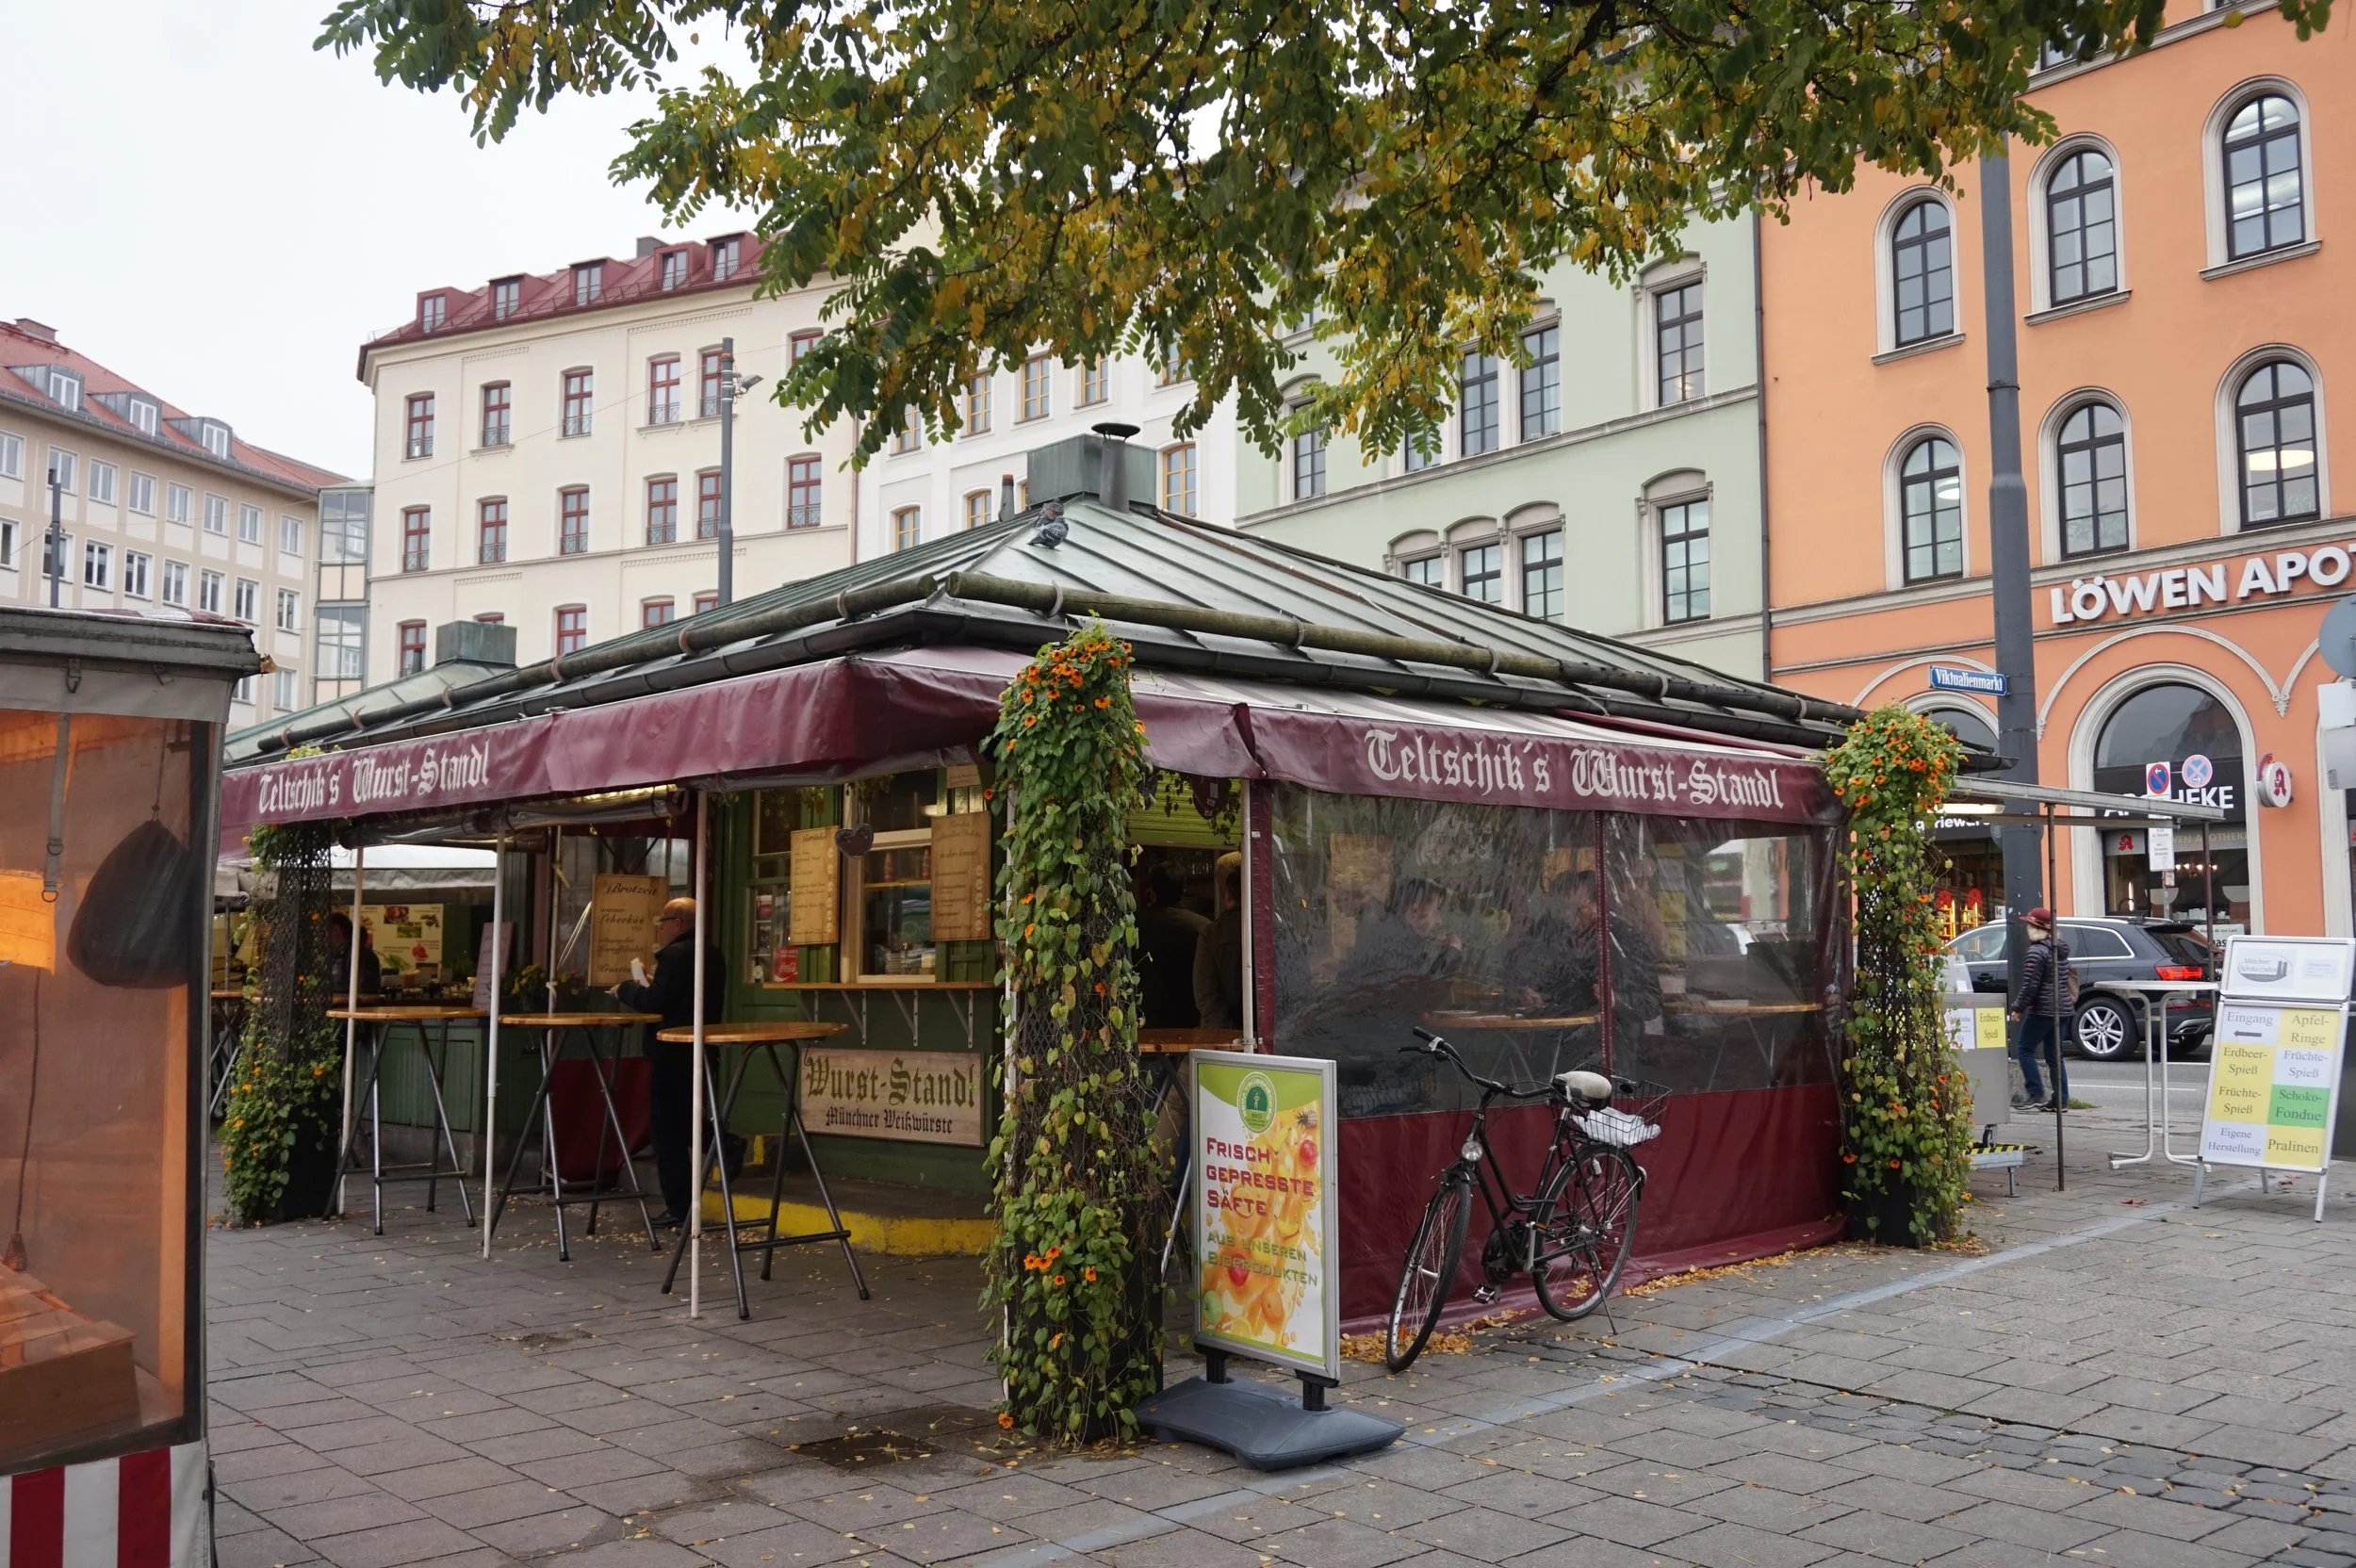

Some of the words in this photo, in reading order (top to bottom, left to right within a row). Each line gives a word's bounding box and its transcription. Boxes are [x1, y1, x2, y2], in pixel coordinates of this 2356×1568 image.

[2050, 564, 2228, 625] LÖWEN
[2236, 544, 2356, 598] APO
[1935, 668, 2004, 692] Viktualienmarkt
[352, 740, 489, 804] Wurst-Standl
[1570, 747, 1785, 809] Wurst-Standl
[2227, 1011, 2274, 1026] Eingang
[2291, 1014, 2330, 1028] Apfel-
[2290, 1032, 2326, 1046] Ringe
[2223, 1047, 2267, 1059] Erdbeer-
[2284, 1050, 2328, 1062] Früchte-
[2228, 1063, 2258, 1075] Spieß
[2288, 1067, 2319, 1079] Spieß
[2218, 1086, 2262, 1098] Früchte-
[2279, 1088, 2322, 1102] Schoko-
[2223, 1102, 2253, 1115] Spieß
[2275, 1106, 2322, 1121] Fondue
[825, 1105, 880, 1128] Münchner
[884, 1108, 954, 1135] Weißwürste
[2220, 1127, 2252, 1138] Eigene
[1206, 1136, 1270, 1164] FRISCH
[2207, 1141, 2262, 1156] Herstellung
[2267, 1138, 2319, 1153] Pralinen
[1206, 1164, 1315, 1198] GEPRESSTE
[1207, 1189, 1268, 1217] SÄFTE
[1207, 1231, 1235, 1248] AUS
[1241, 1236, 1307, 1263] UNSEREN
